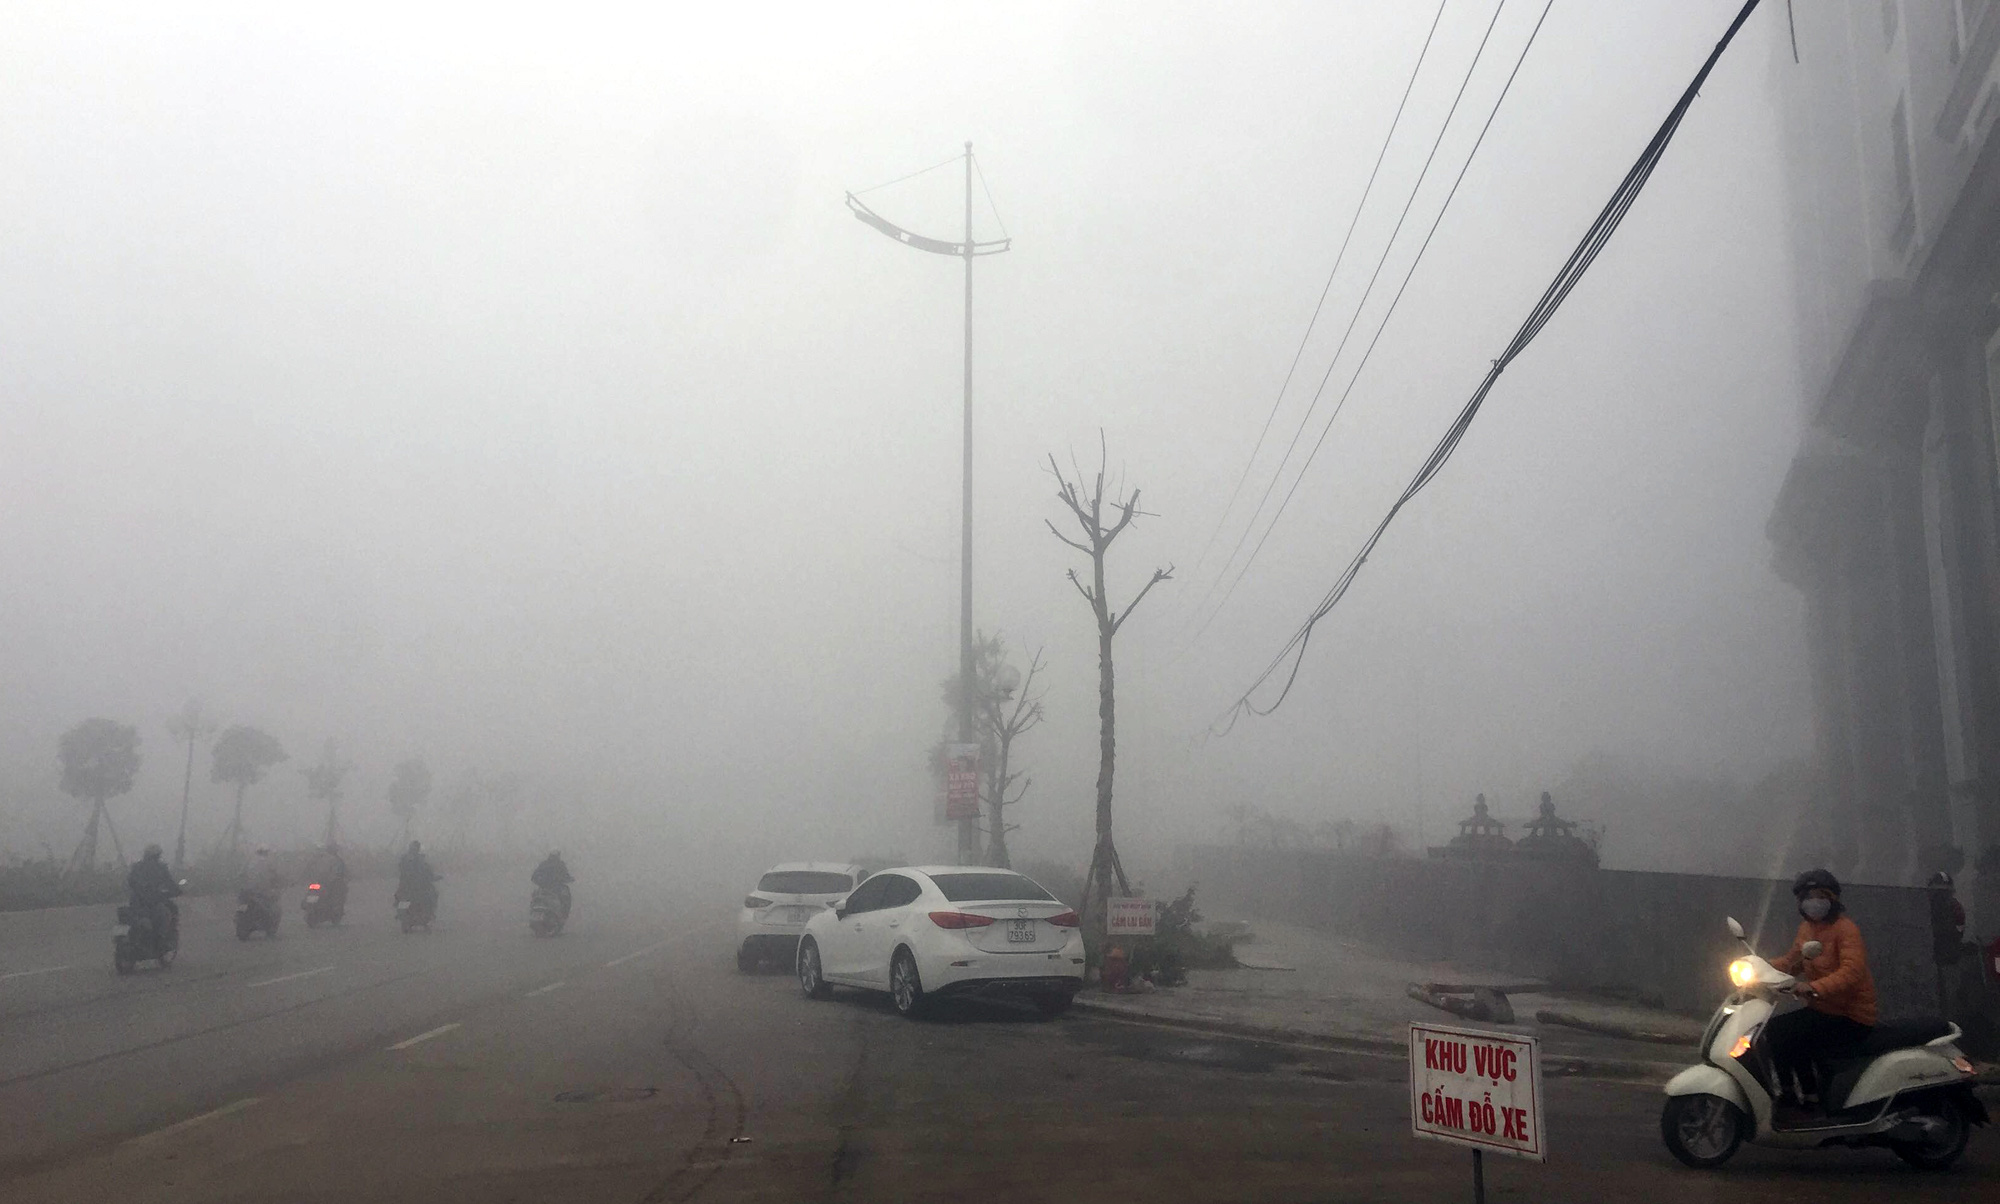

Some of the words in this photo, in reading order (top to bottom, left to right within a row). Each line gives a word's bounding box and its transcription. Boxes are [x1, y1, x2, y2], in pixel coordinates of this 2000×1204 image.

[1009, 930, 1035, 941] 79365
[1425, 1038, 1467, 1074] KHU
[1473, 1044, 1517, 1087] VỰC
[1421, 1084, 1464, 1130] CẤM
[1469, 1091, 1496, 1136] ĐỖ
[1501, 1106, 1529, 1142] XE
